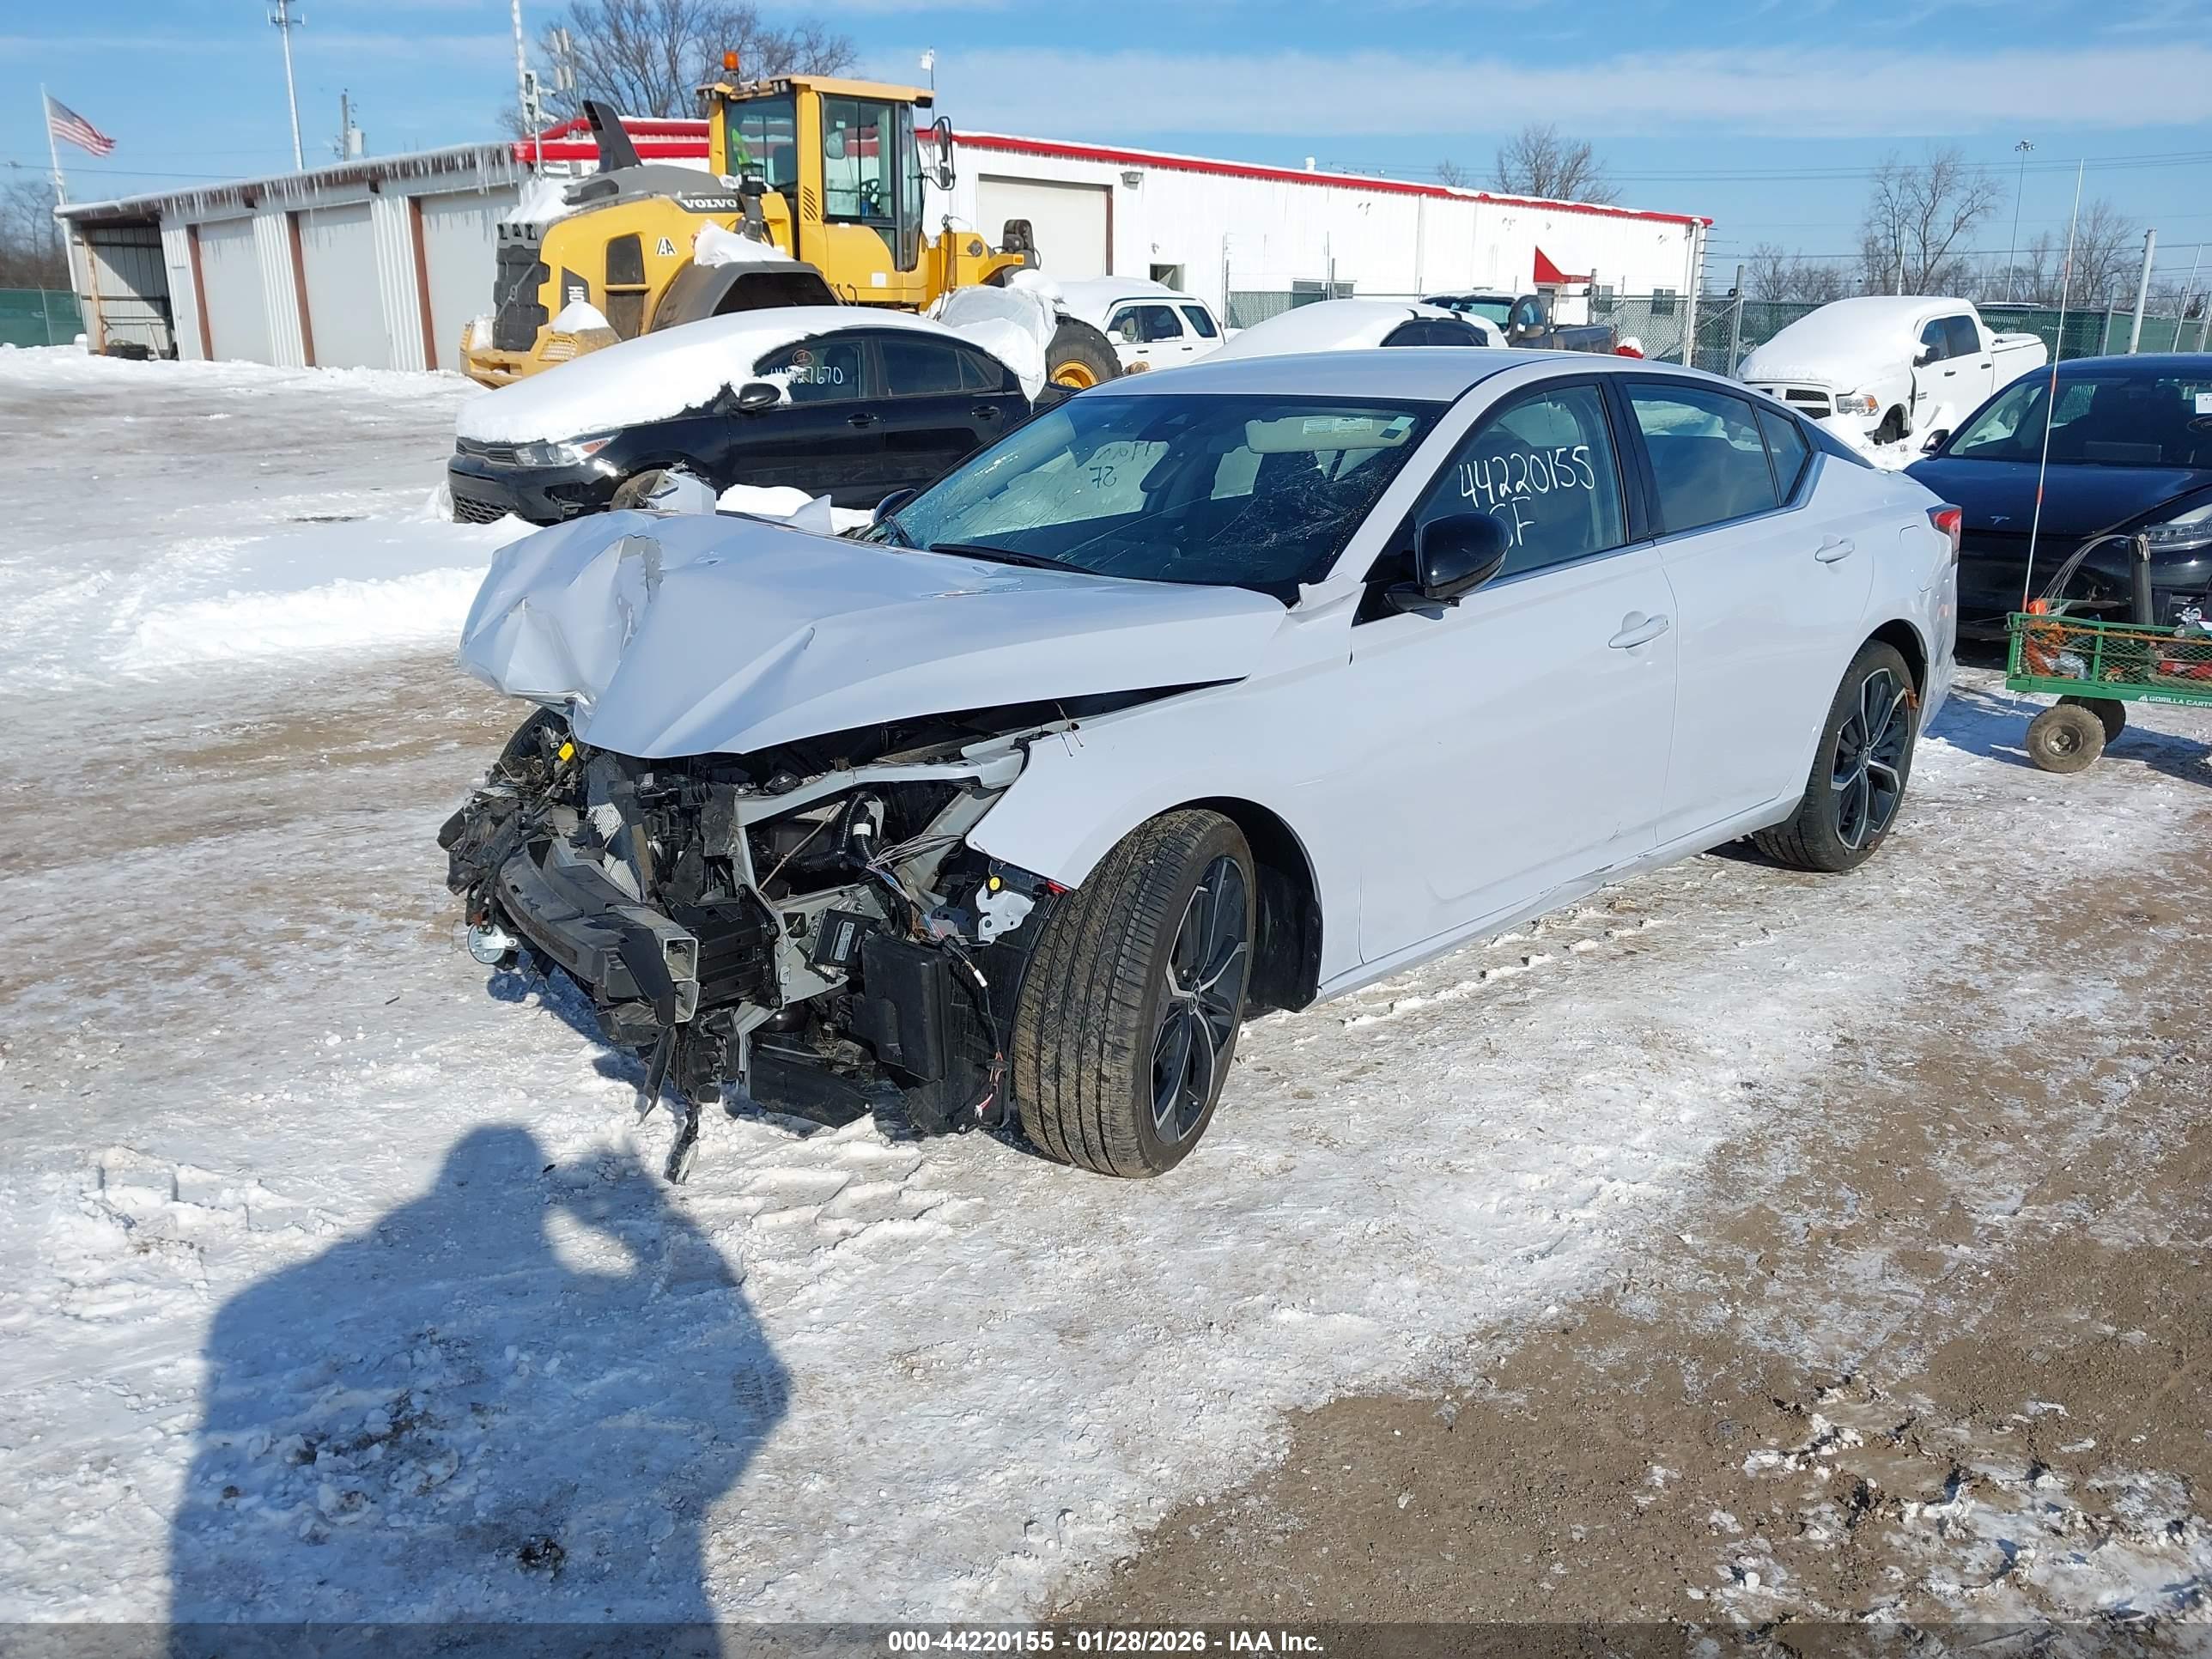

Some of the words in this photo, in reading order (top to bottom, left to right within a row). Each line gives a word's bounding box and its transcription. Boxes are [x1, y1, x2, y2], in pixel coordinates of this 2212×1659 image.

[680, 198, 738, 209] VOLVO
[1459, 446, 1595, 508] 44220155
[2149, 696, 2185, 704] GORILLA
